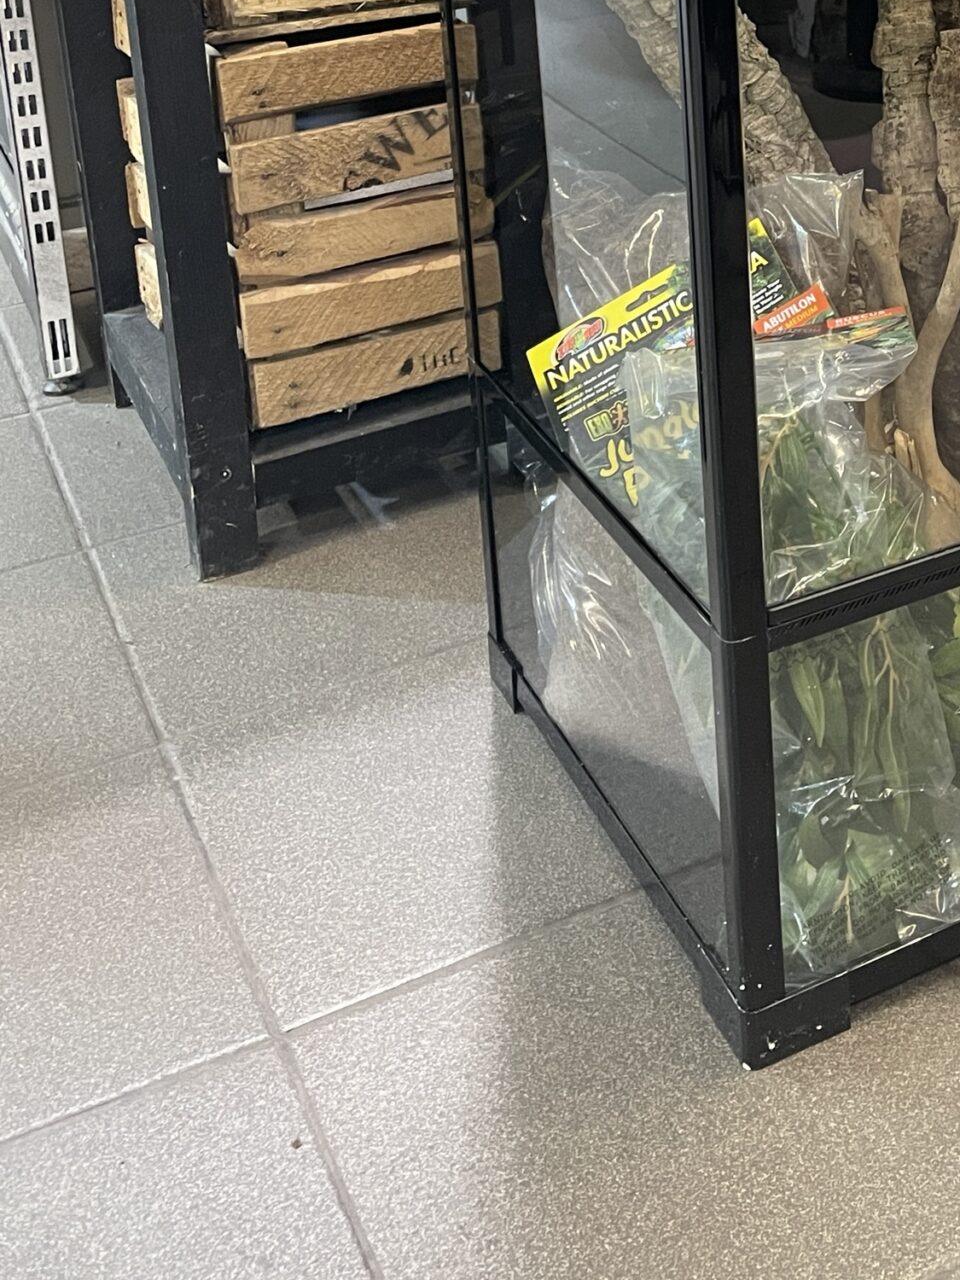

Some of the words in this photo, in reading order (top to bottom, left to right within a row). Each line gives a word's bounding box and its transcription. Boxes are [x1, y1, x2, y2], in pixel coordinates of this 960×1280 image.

[762, 293, 817, 332] ABUTILON
[783, 305, 819, 330] MEDIUM
[546, 290, 695, 391] NATURALISTIC
